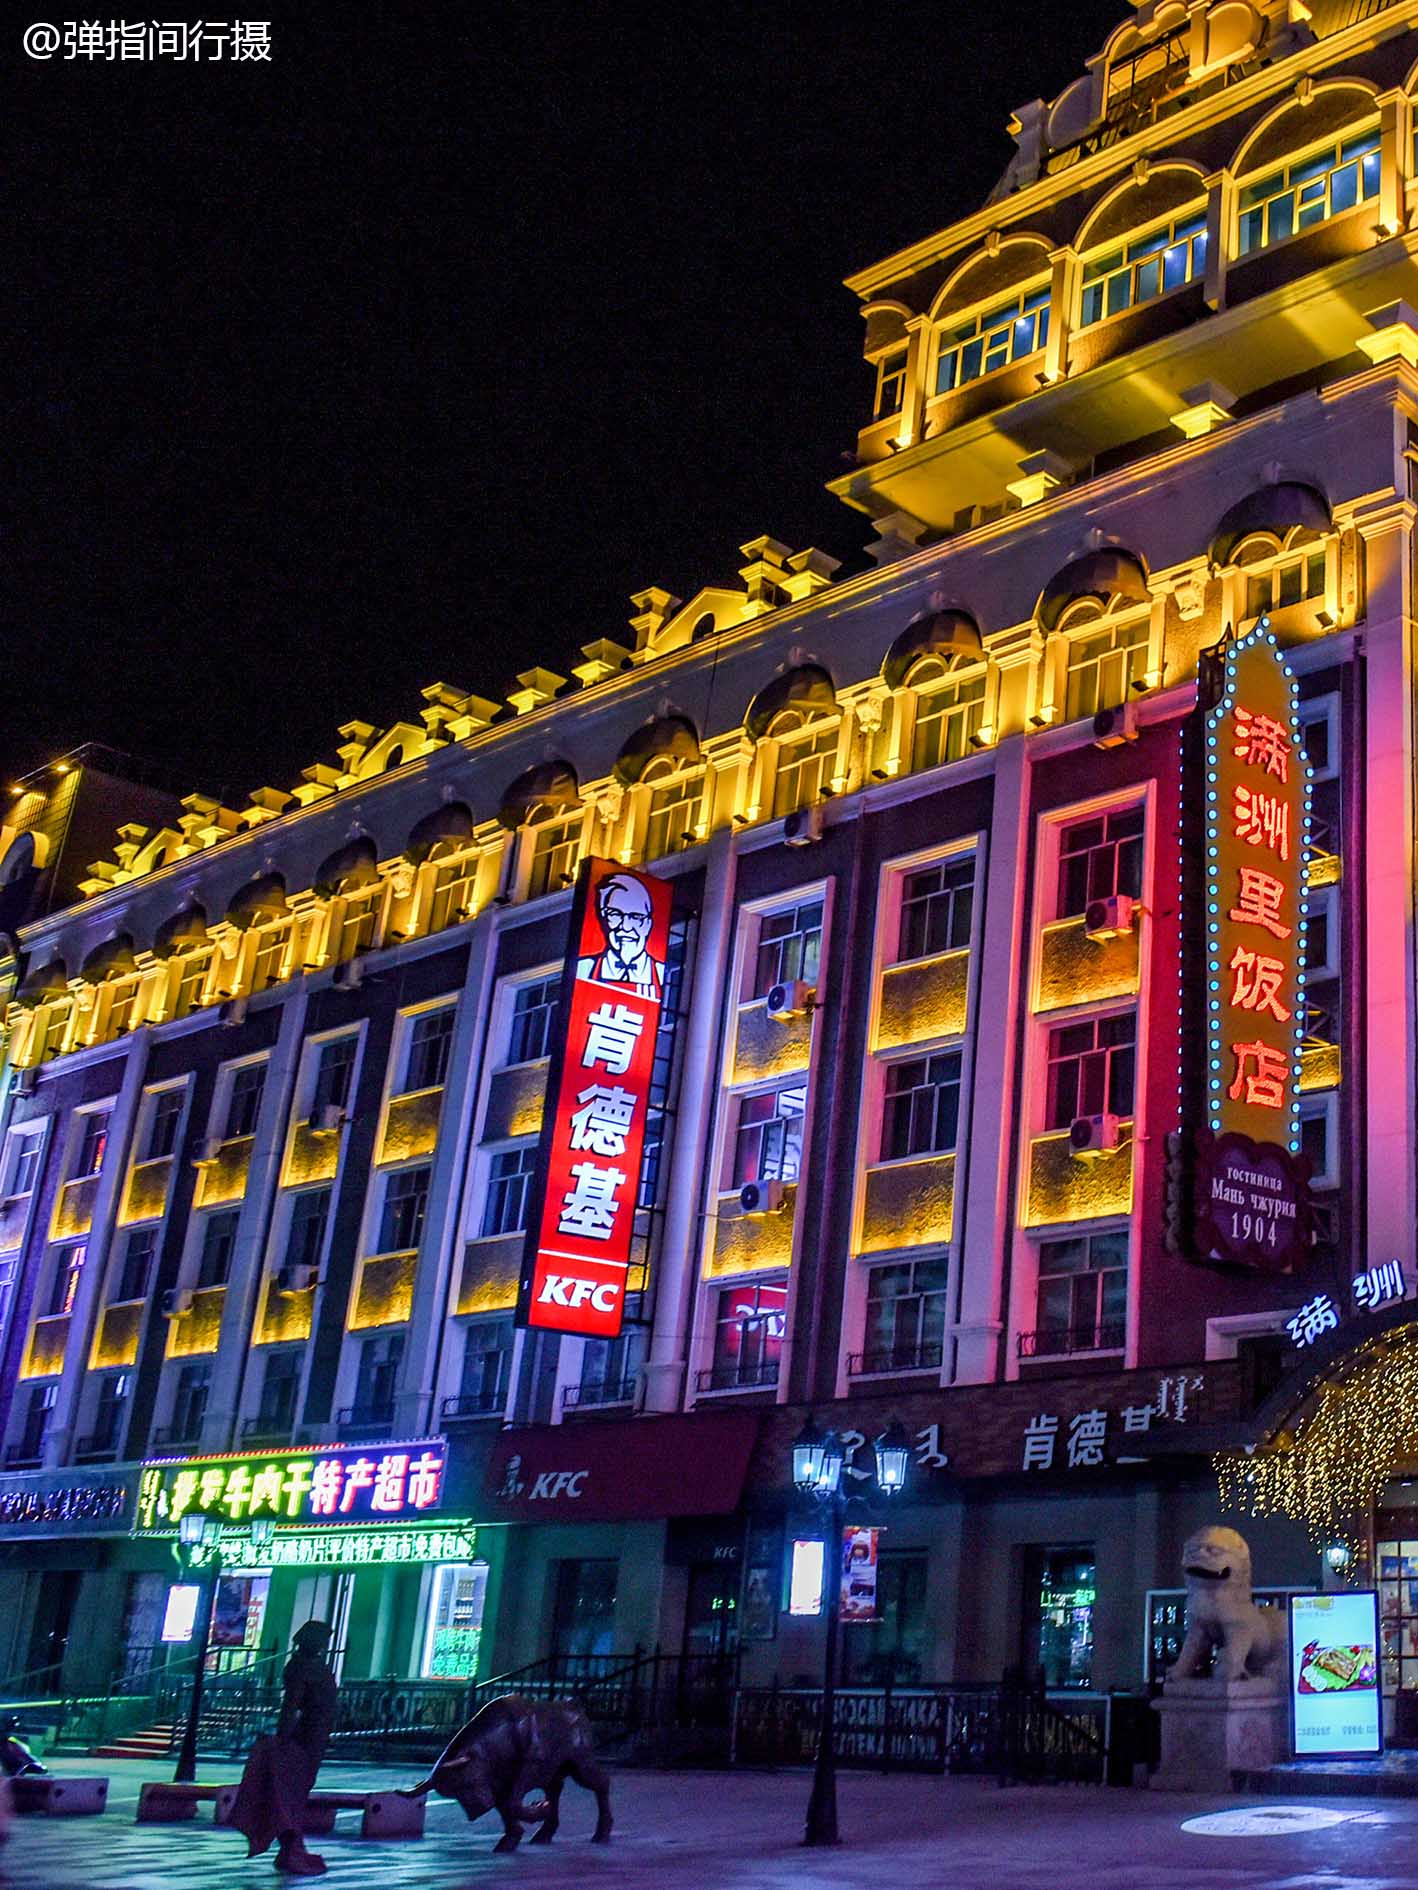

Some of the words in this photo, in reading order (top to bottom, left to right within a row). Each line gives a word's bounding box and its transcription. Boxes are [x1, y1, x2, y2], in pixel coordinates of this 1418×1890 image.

[558, 1002, 644, 1241] 肯德基
[1211, 1177, 1245, 1206] Мань
[1227, 1167, 1282, 1191] гостиница
[1231, 1212, 1277, 1248] 1904
[537, 1274, 620, 1313] KFC
[528, 1470, 590, 1500] KFC
